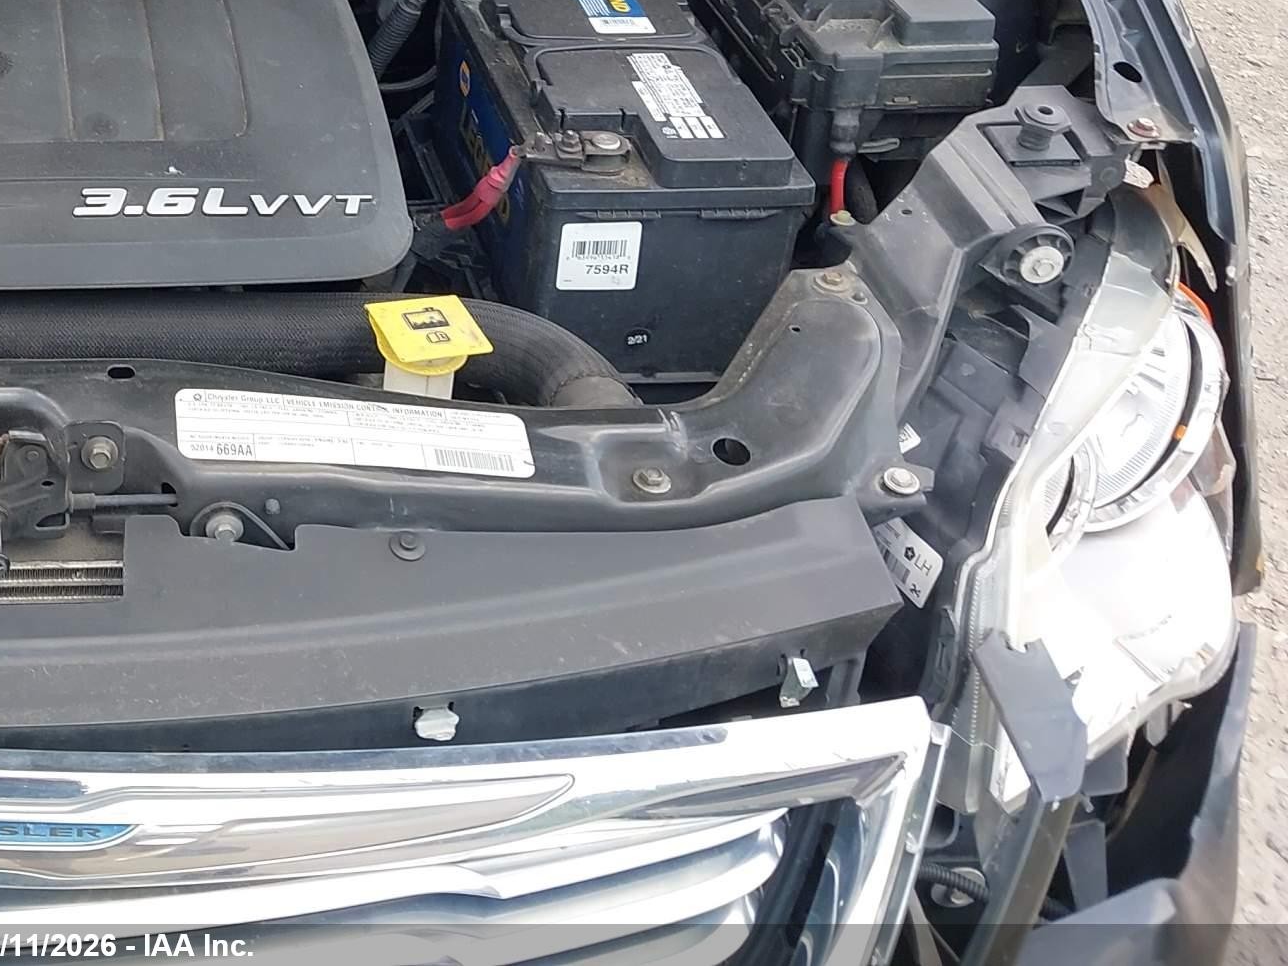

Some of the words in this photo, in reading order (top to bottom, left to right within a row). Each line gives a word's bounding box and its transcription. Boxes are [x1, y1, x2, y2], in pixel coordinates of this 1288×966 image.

[72, 187, 250, 217] 3.6L
[249, 193, 374, 216] VVT
[585, 263, 630, 275] 7594R
[626, 333, 649, 346] 2/21
[207, 392, 239, 404] Chrysler
[240, 393, 264, 404] Group
[266, 395, 281, 405] LLC
[286, 398, 317, 408] VEHICLE
[318, 400, 355, 411] EMISSION
[392, 407, 444, 419] INFORMATION
[215, 441, 253, 457] 669AA
[913, 552, 933, 577] LH
